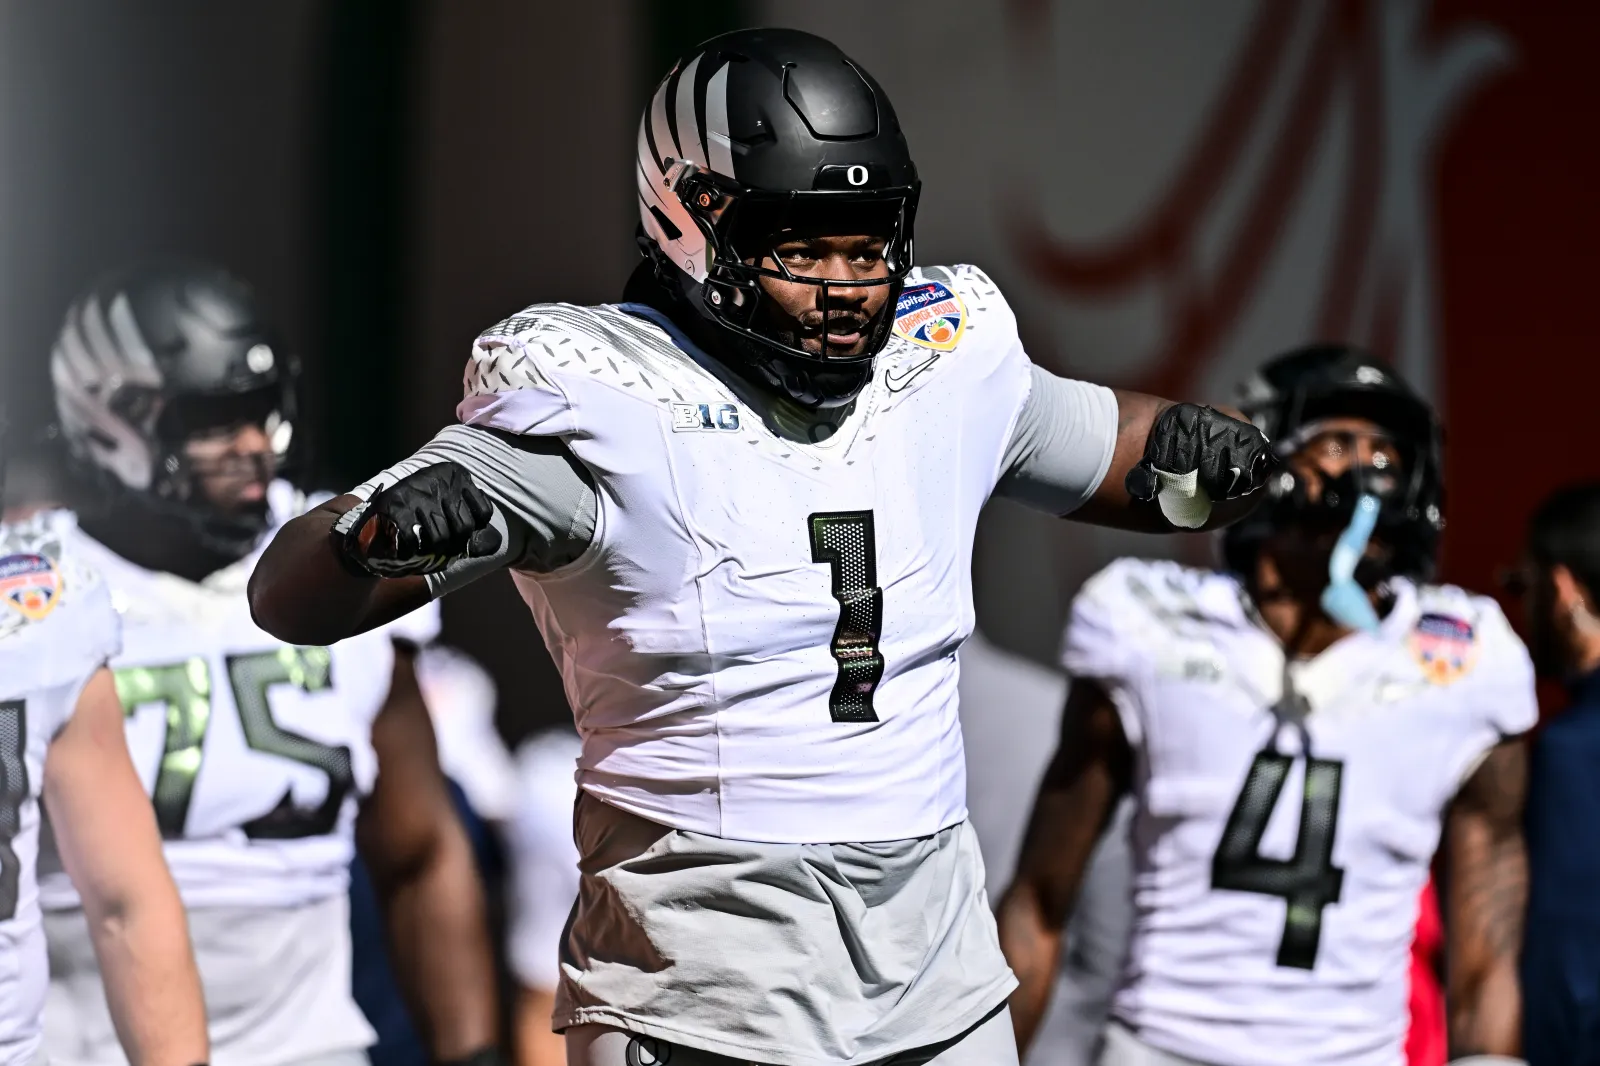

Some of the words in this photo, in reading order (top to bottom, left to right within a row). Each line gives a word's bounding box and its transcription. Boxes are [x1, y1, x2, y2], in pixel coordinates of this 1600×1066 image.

[847, 165, 869, 186] O
[896, 289, 947, 311] apitalOne
[897, 308, 933, 334] ORANGE
[931, 300, 960, 316] BOWL
[807, 509, 885, 723] 1
[112, 644, 357, 841] 75
[1210, 749, 1346, 971] 4
